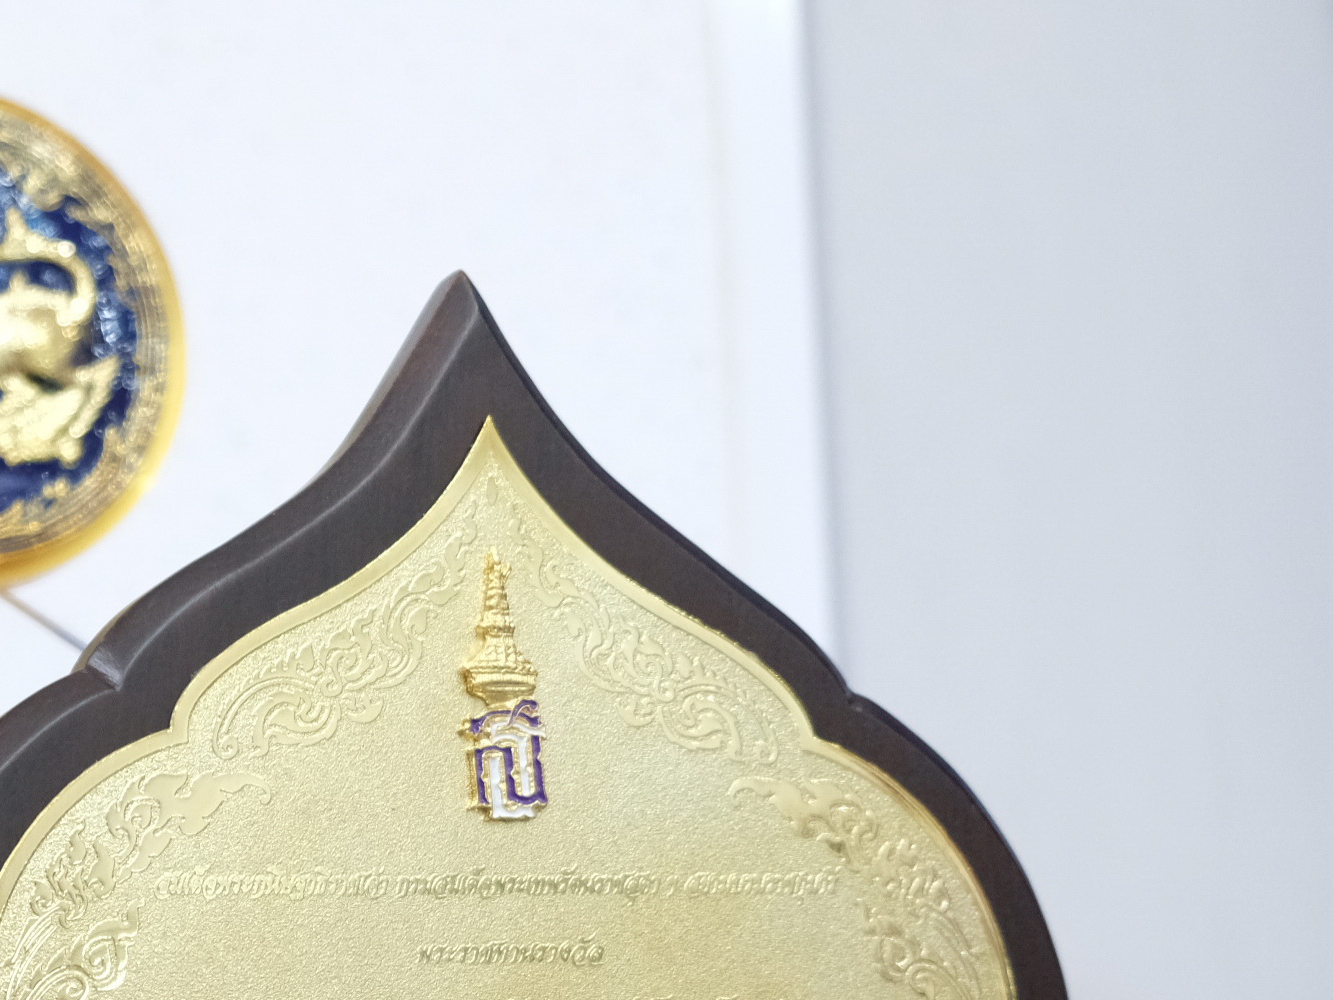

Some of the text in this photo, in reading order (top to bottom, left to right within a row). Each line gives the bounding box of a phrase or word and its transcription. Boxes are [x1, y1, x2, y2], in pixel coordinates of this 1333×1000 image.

[416, 928, 605, 966] พระราชทานรางวัล
